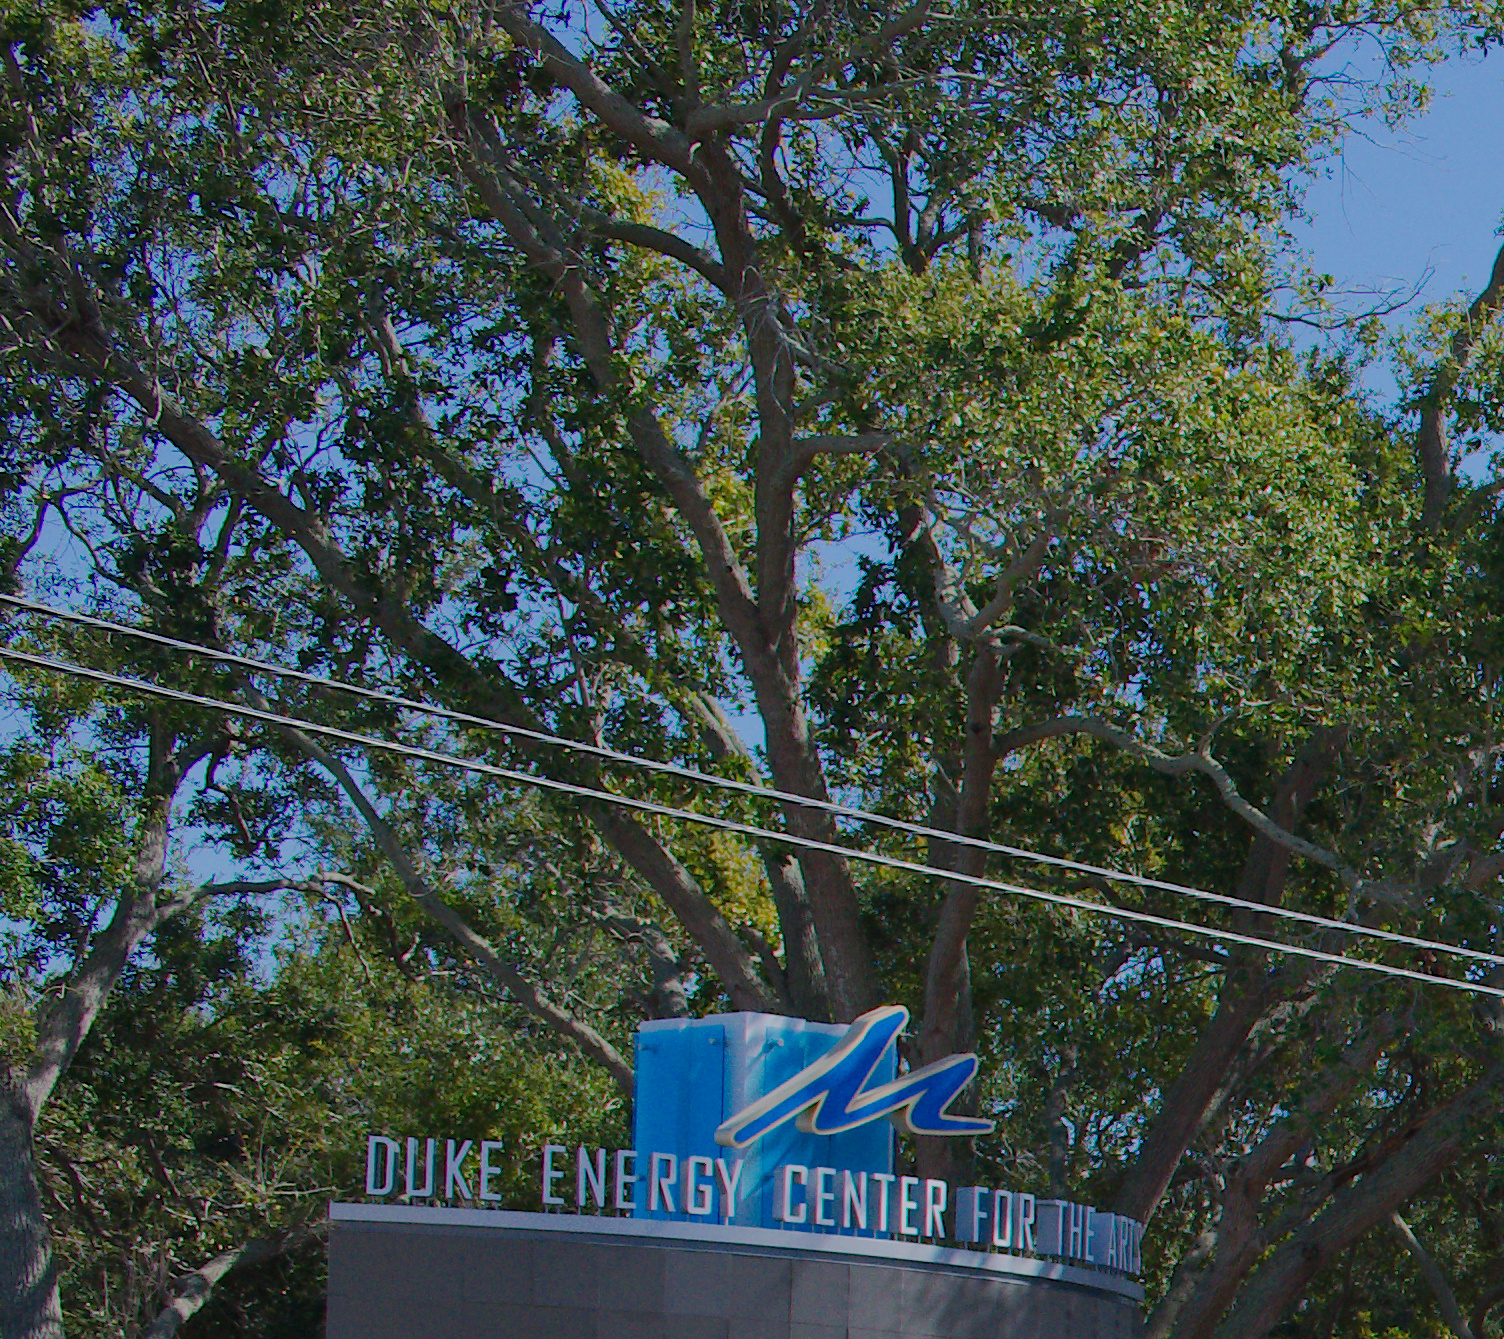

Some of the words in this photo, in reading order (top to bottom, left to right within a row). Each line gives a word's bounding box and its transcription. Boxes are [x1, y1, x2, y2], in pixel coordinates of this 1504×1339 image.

[365, 1134, 503, 1201] DUKE
[541, 1143, 744, 1218] ENERGY
[781, 1163, 948, 1239] CENTER
[973, 1185, 1036, 1251] FOR
[1054, 1199, 1097, 1263] THE
